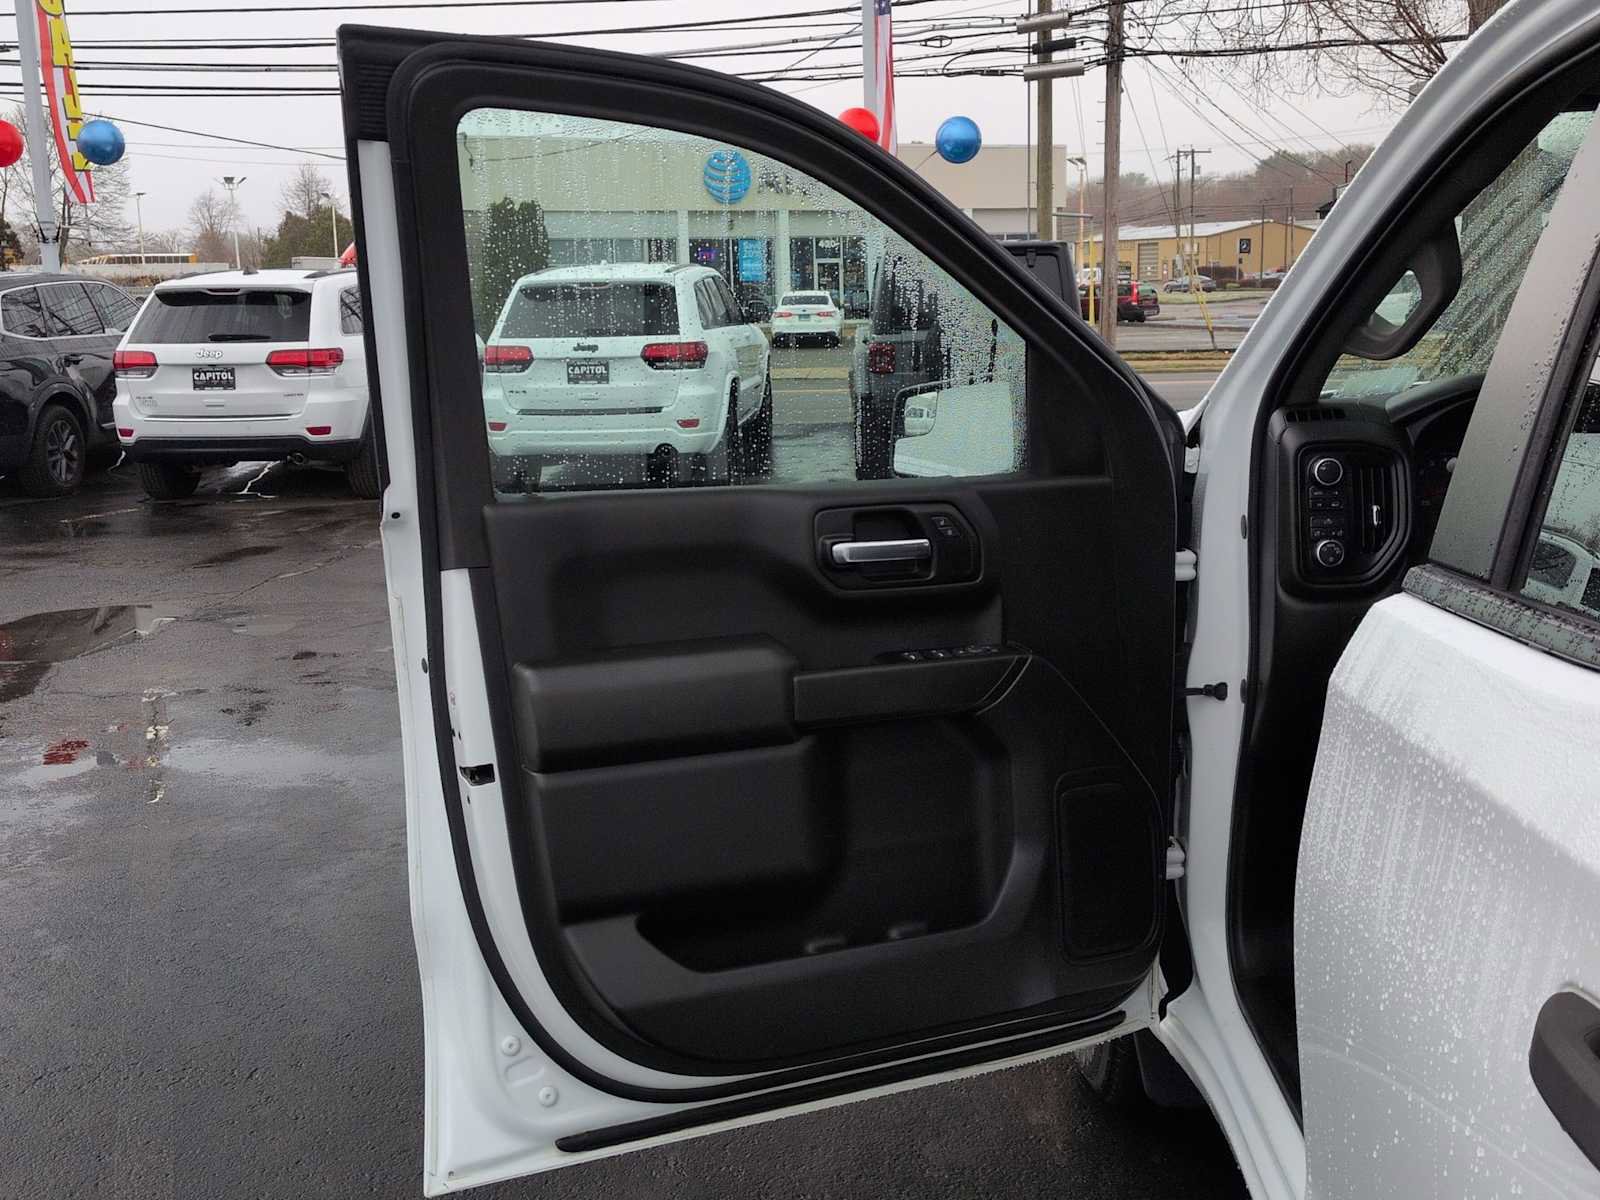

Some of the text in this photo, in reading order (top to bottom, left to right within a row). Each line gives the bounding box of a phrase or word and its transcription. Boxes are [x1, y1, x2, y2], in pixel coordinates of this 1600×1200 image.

[196, 349, 223, 360] Jeep
[568, 365, 608, 375] CAPITOL
[194, 371, 234, 381] CAPITOL
